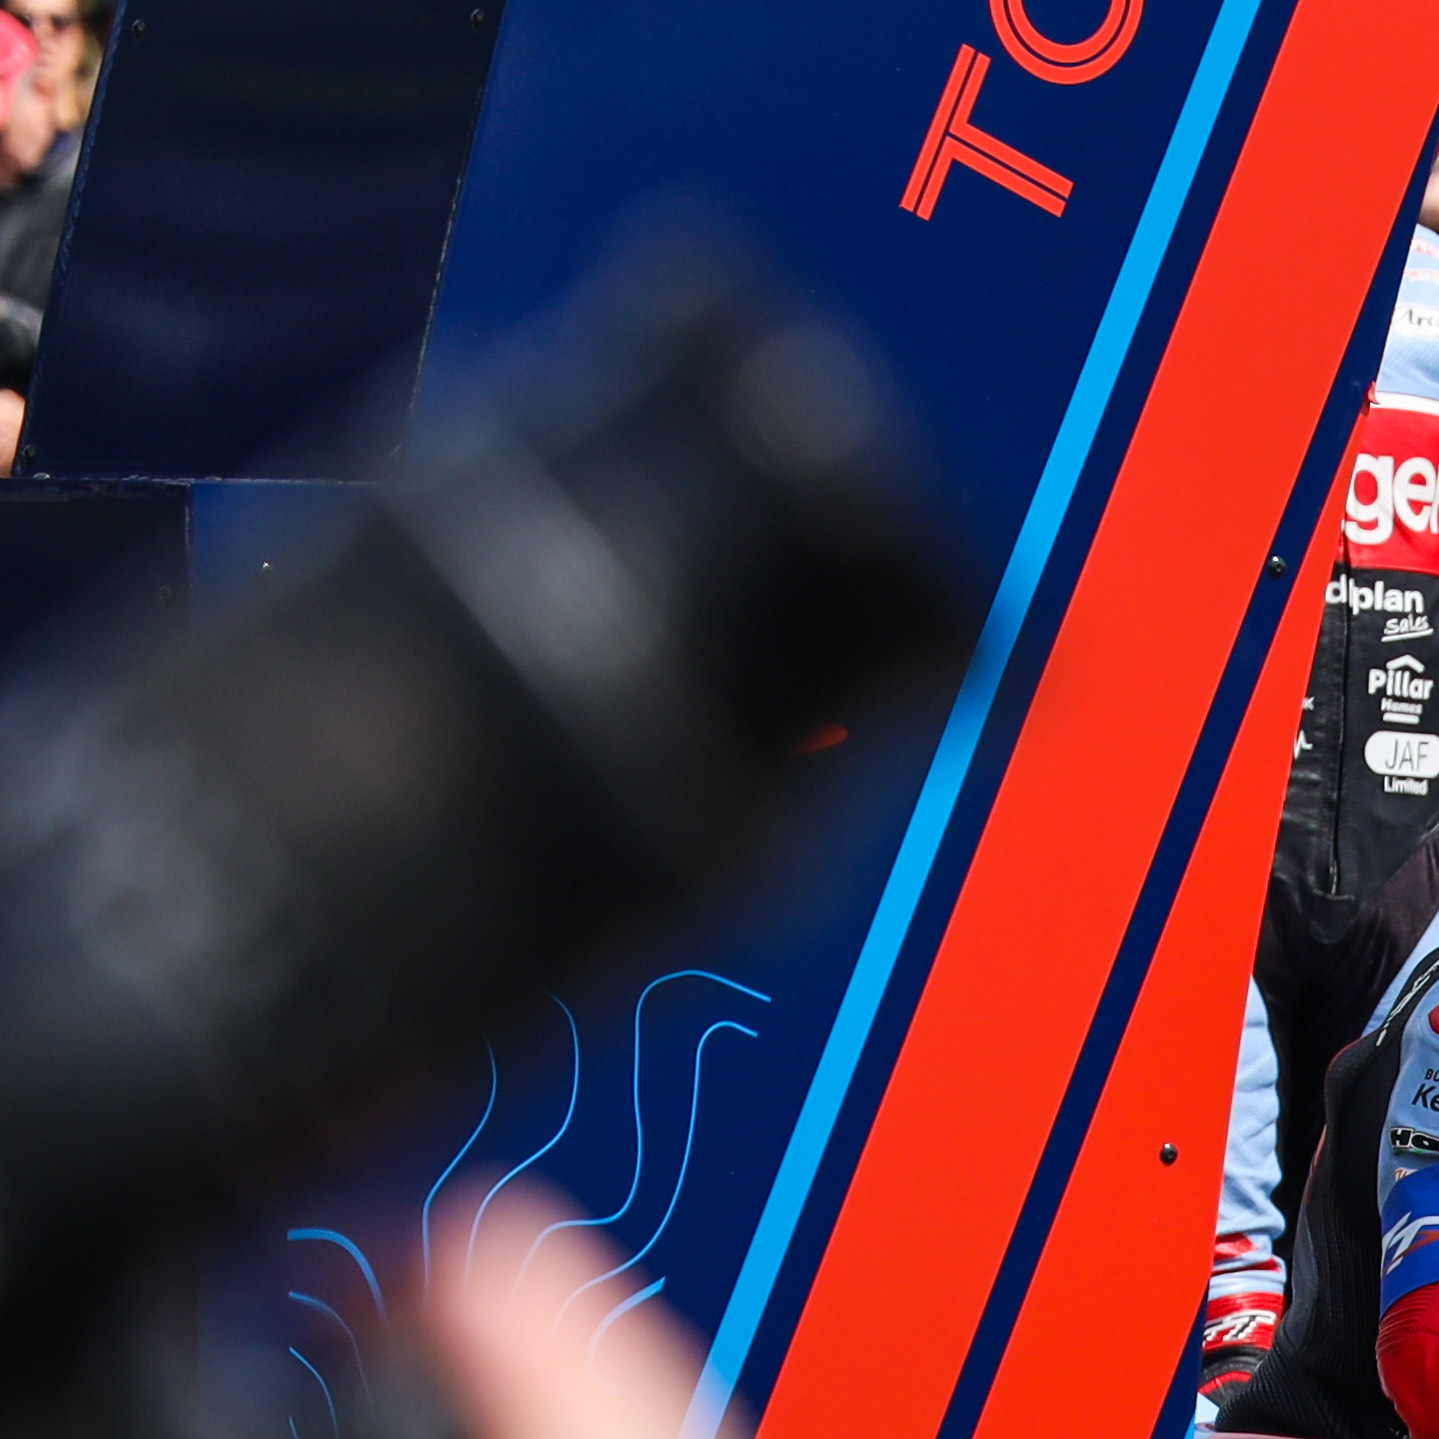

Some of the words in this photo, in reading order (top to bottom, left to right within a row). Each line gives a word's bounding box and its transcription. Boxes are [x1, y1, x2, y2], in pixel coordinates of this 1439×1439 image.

[1367, 667, 1435, 701] Pillar
[1384, 739, 1429, 773] JAF
[1384, 775, 1428, 797] Limited
